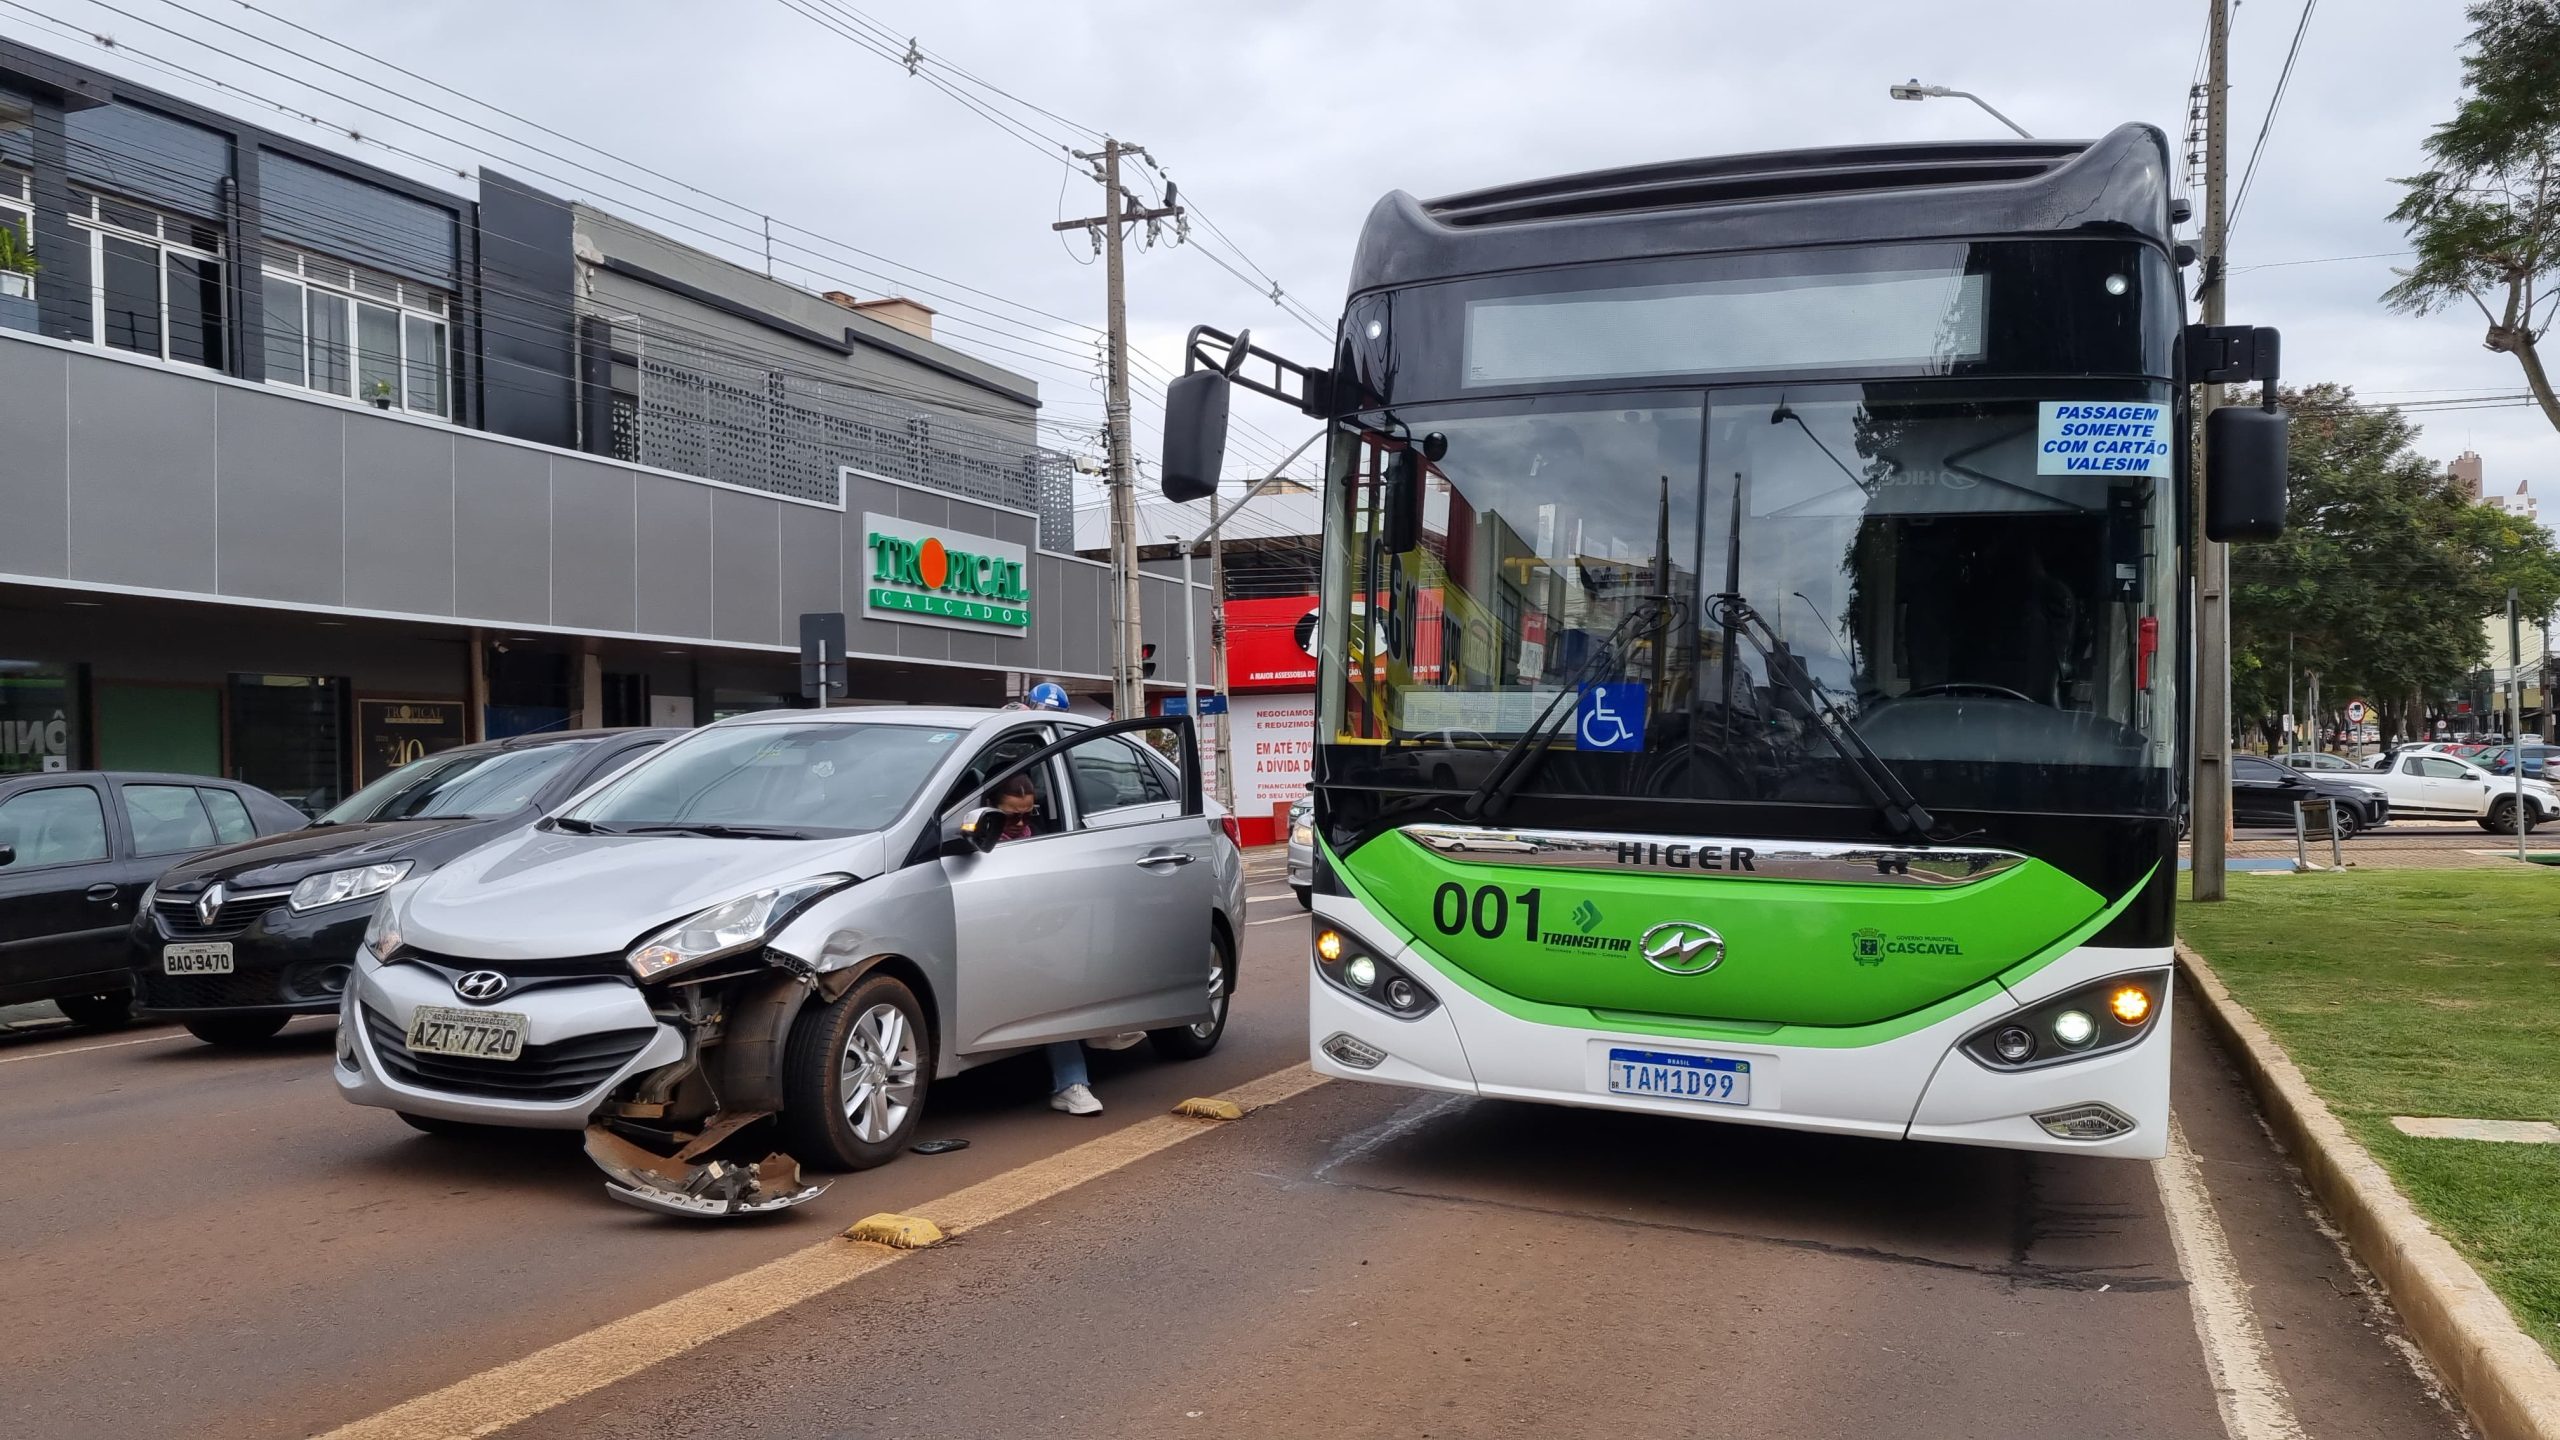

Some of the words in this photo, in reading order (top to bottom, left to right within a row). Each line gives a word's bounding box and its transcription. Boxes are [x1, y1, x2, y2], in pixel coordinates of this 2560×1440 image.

[2055, 406, 2159, 420] PASSAGEM
[2061, 423, 2154, 437] SOMENTE
[2043, 440, 2088, 453] COM
[2093, 440, 2168, 455] CARTÃO
[2067, 457, 2150, 471] VALESIM
[869, 532, 1030, 603] TROPICAL
[881, 591, 1028, 624] CALÇADOS
[1256, 709, 1314, 718] NEGOCIAMOS
[1265, 721, 1315, 729] REDUZIMOS
[1256, 742, 1271, 755] EM
[1274, 739, 1293, 754] ATÉ
[1256, 760, 1264, 773] A
[1266, 757, 1300, 773] DÍVIDA
[1303, 759, 1313, 772] D
[1617, 841, 1756, 872] HIGER
[1433, 881, 1541, 942] 001
[1542, 932, 1632, 952] TRANSITAR
[1886, 942, 1964, 955] CASCAVEL
[1667, 1058, 1690, 1066] BRASIL
[1611, 1081, 1620, 1089] BR
[1622, 1064, 1734, 1098] TAM1D99
